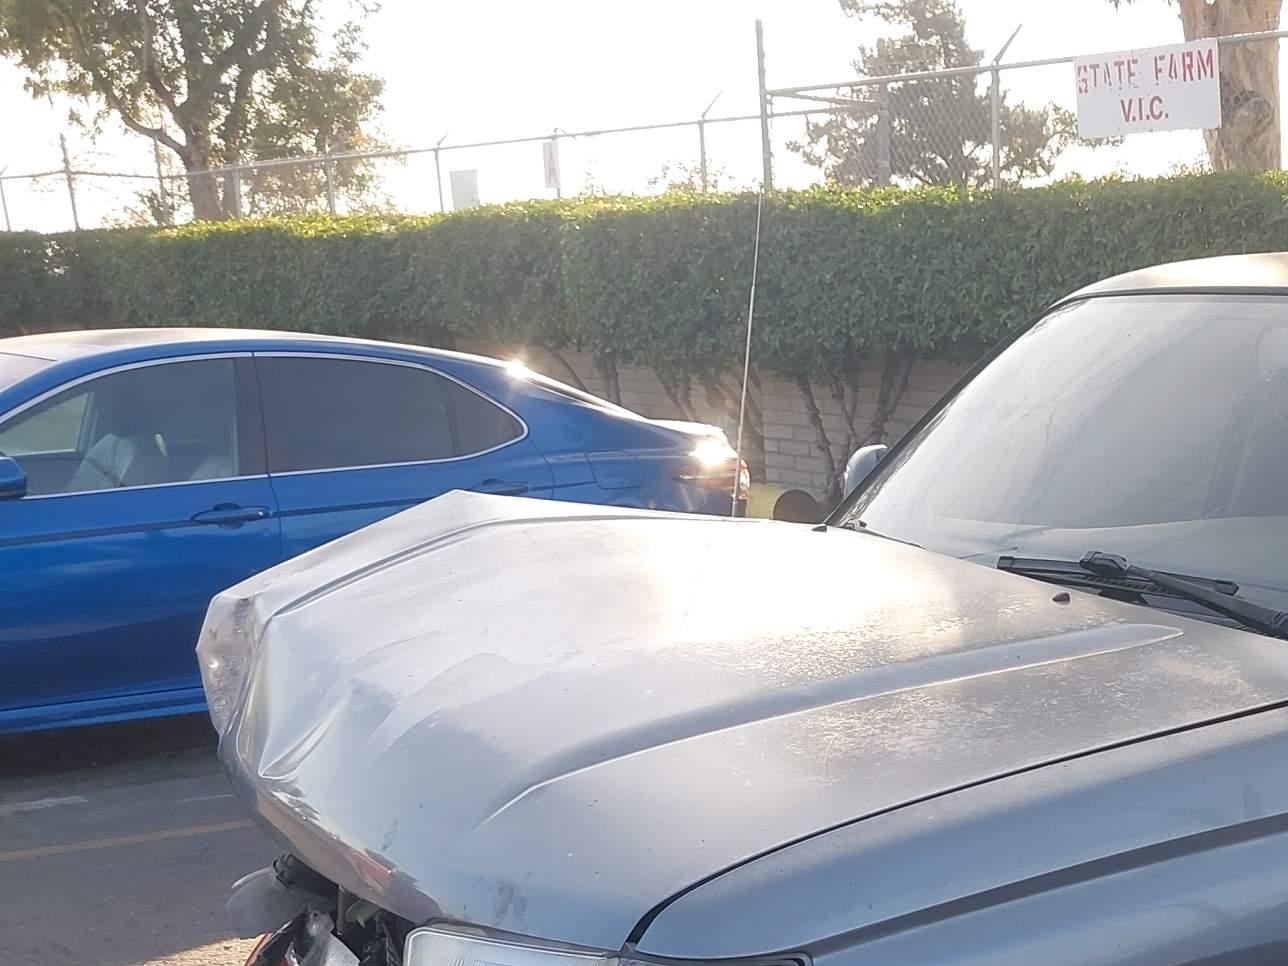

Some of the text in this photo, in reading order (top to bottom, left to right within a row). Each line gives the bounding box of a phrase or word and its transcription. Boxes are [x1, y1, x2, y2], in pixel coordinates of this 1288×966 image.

[1077, 48, 1214, 93] STATE FARM
[1119, 95, 1169, 122] V.I.C.
